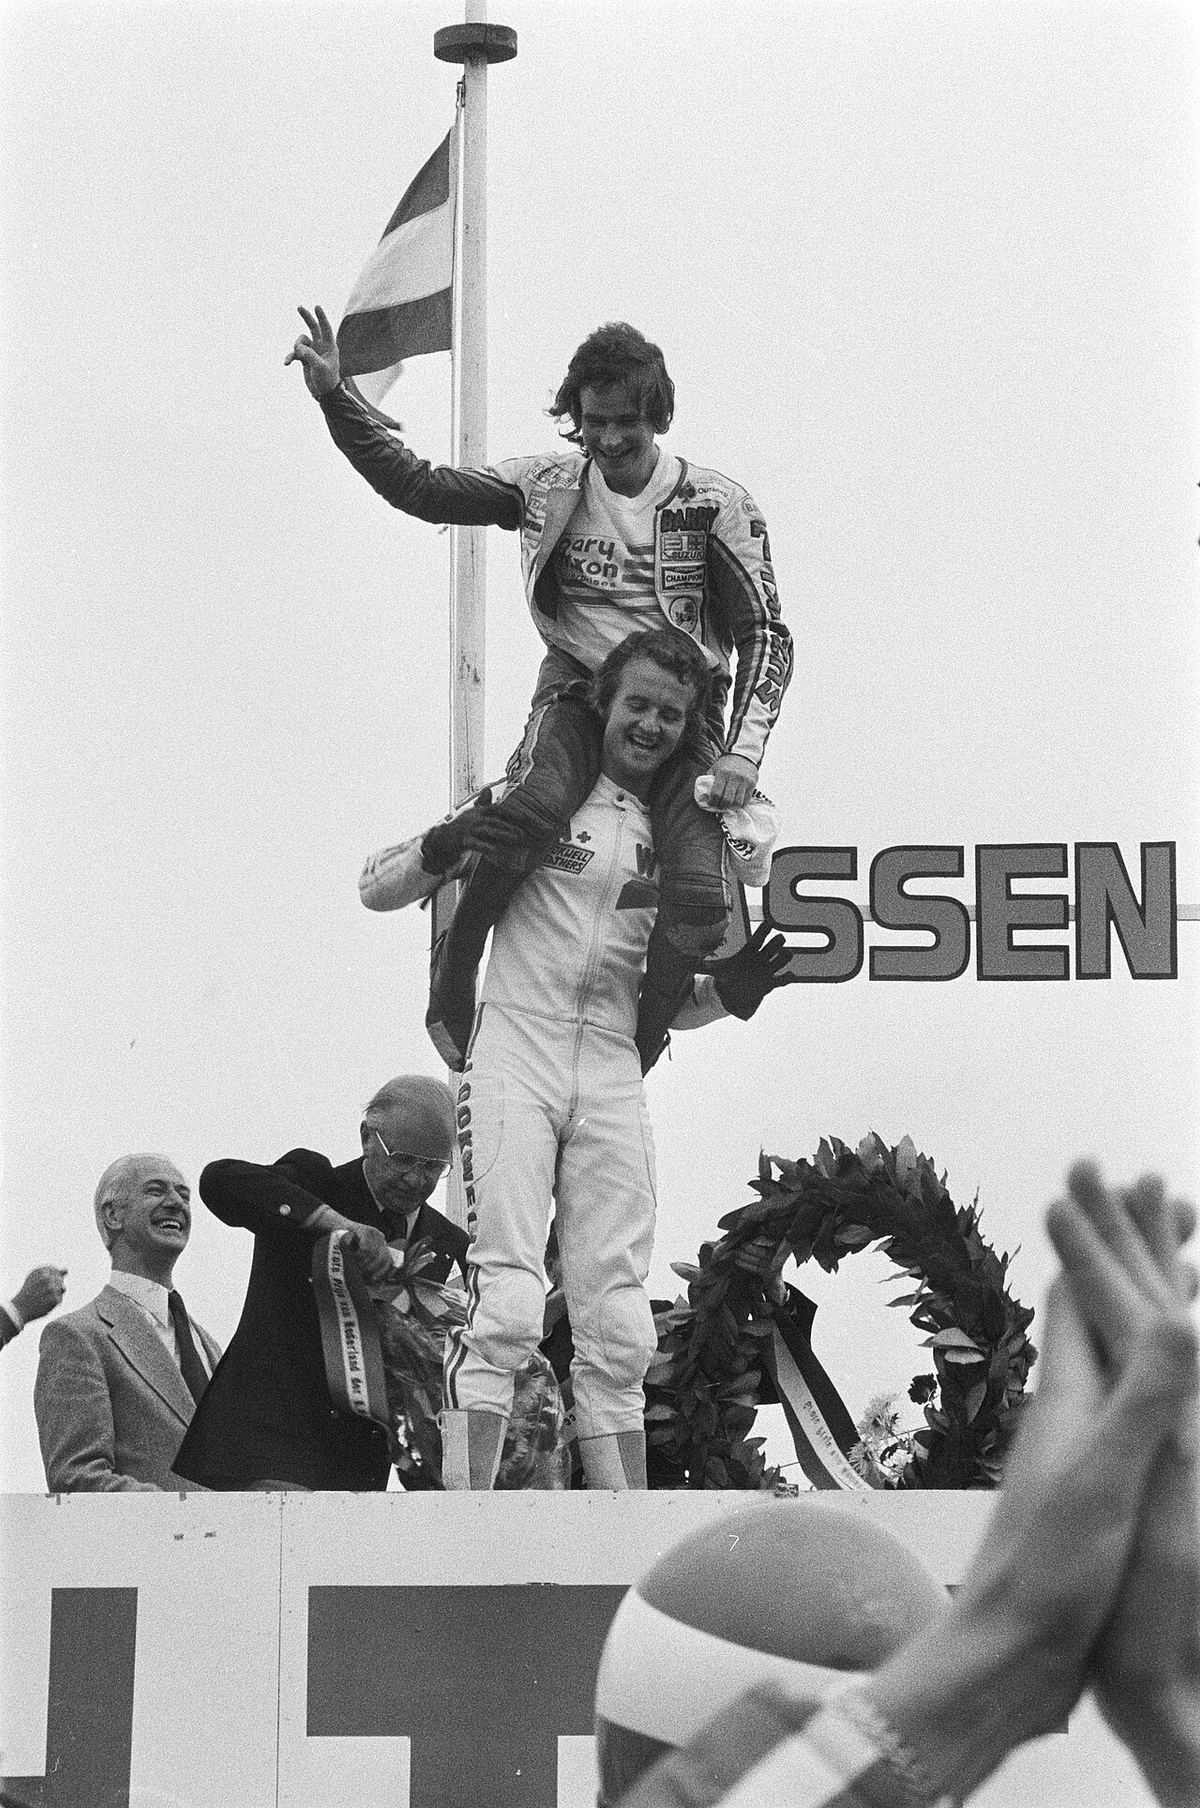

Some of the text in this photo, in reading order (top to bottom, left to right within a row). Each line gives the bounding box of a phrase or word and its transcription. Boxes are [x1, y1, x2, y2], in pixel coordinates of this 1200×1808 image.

[661, 506, 720, 533] BARRY
[564, 554, 618, 578] ixon
[666, 573, 703, 582] CHAMPION
[351, 1377, 363, 1394] der
